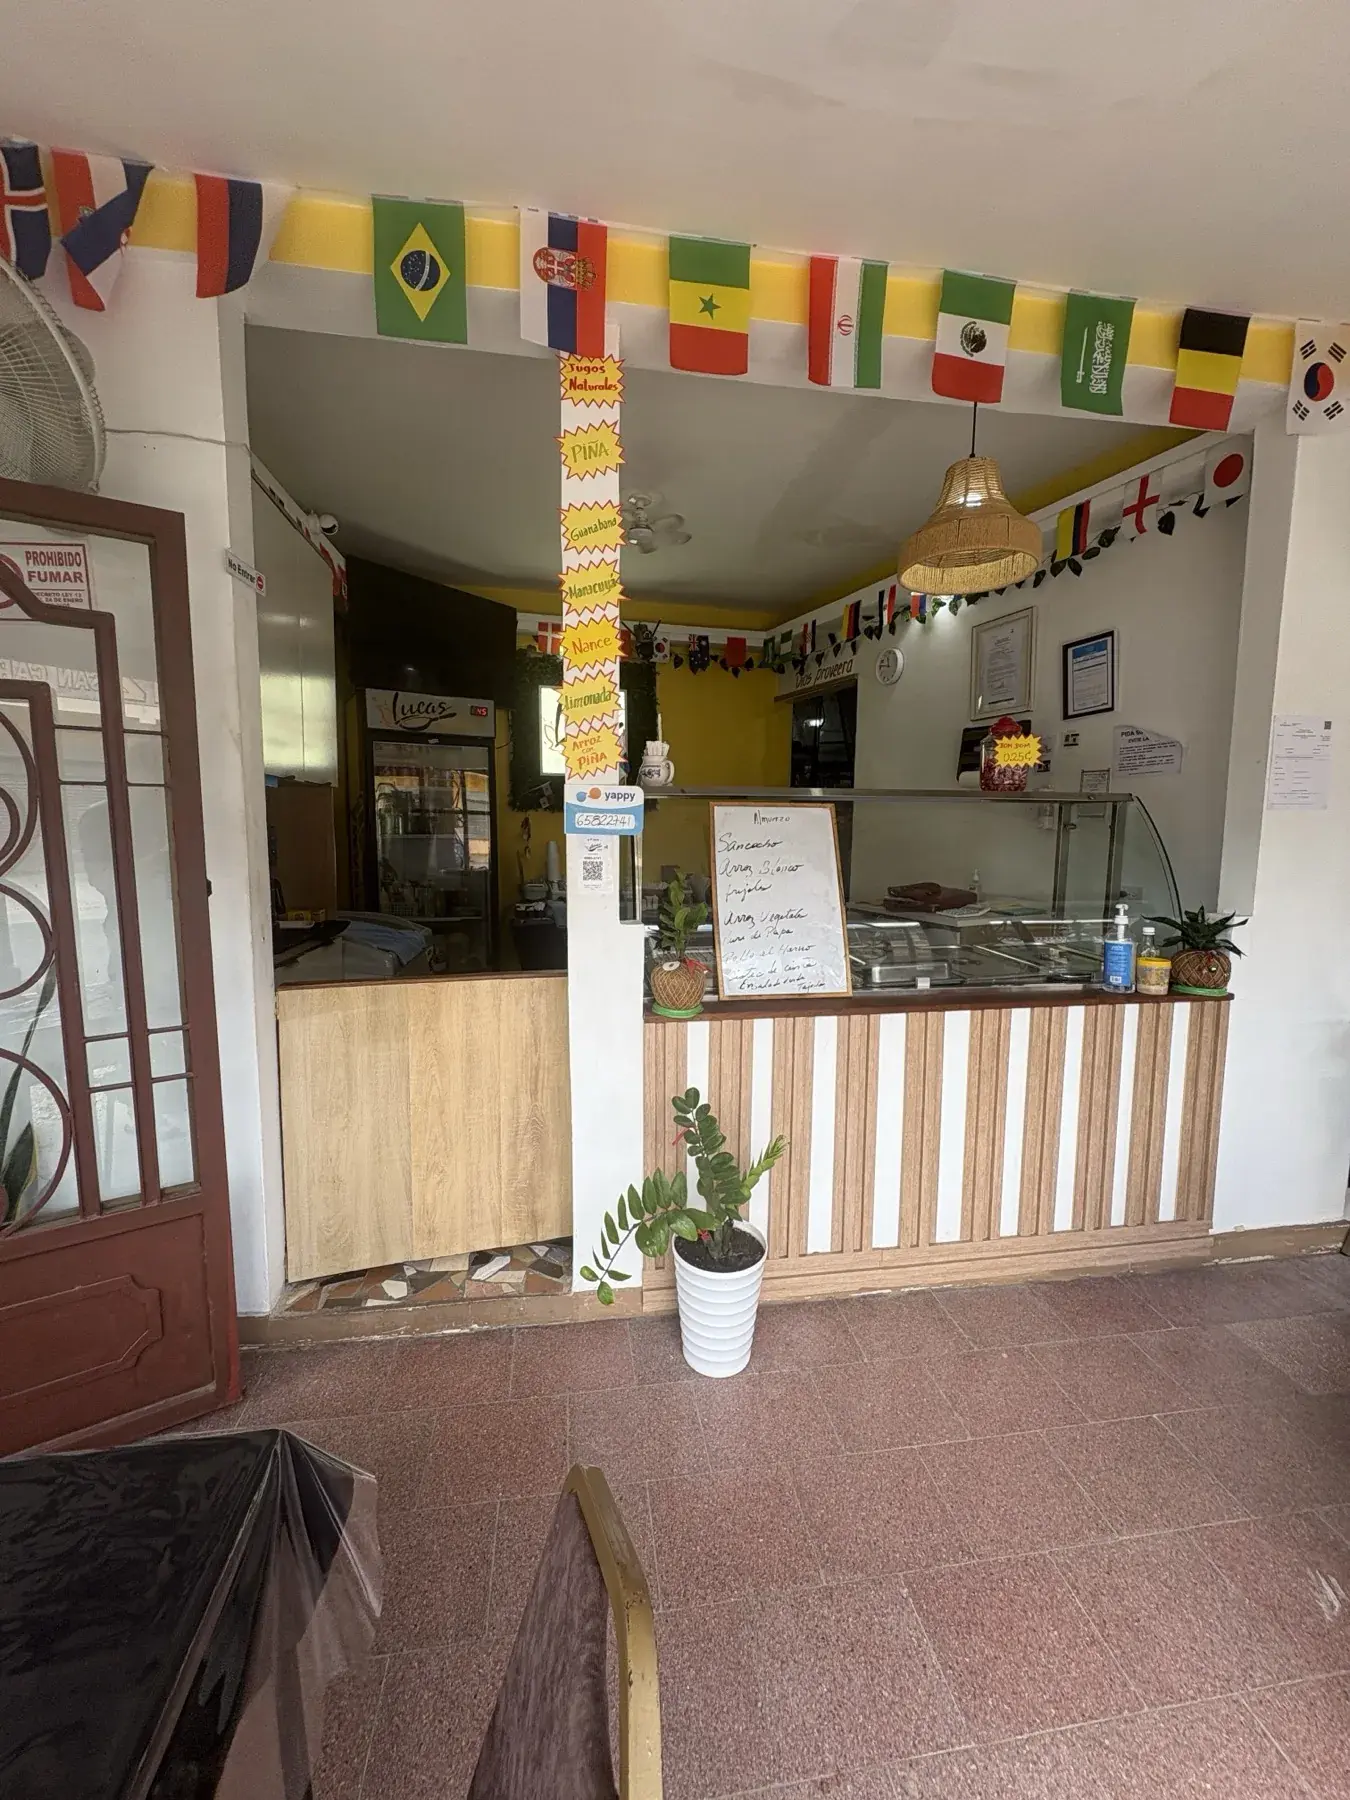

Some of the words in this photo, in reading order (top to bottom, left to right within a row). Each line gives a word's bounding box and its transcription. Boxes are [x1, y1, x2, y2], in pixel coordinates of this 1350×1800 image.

[568, 363, 606, 375] Jugos
[569, 376, 618, 391] Naturales
[571, 440, 610, 463] PIÑA
[25, 551, 82, 567] PROHIBIDO
[27, 571, 84, 583] FUMAR
[228, 557, 237, 572] No
[237, 564, 256, 584] Entrar
[572, 637, 612, 656] Nance
[393, 691, 452, 725] Lucas
[572, 735, 602, 751] Arroz
[577, 751, 607, 769] PIÑA
[604, 790, 635, 802] yappy
[577, 814, 631, 827] 65822741
